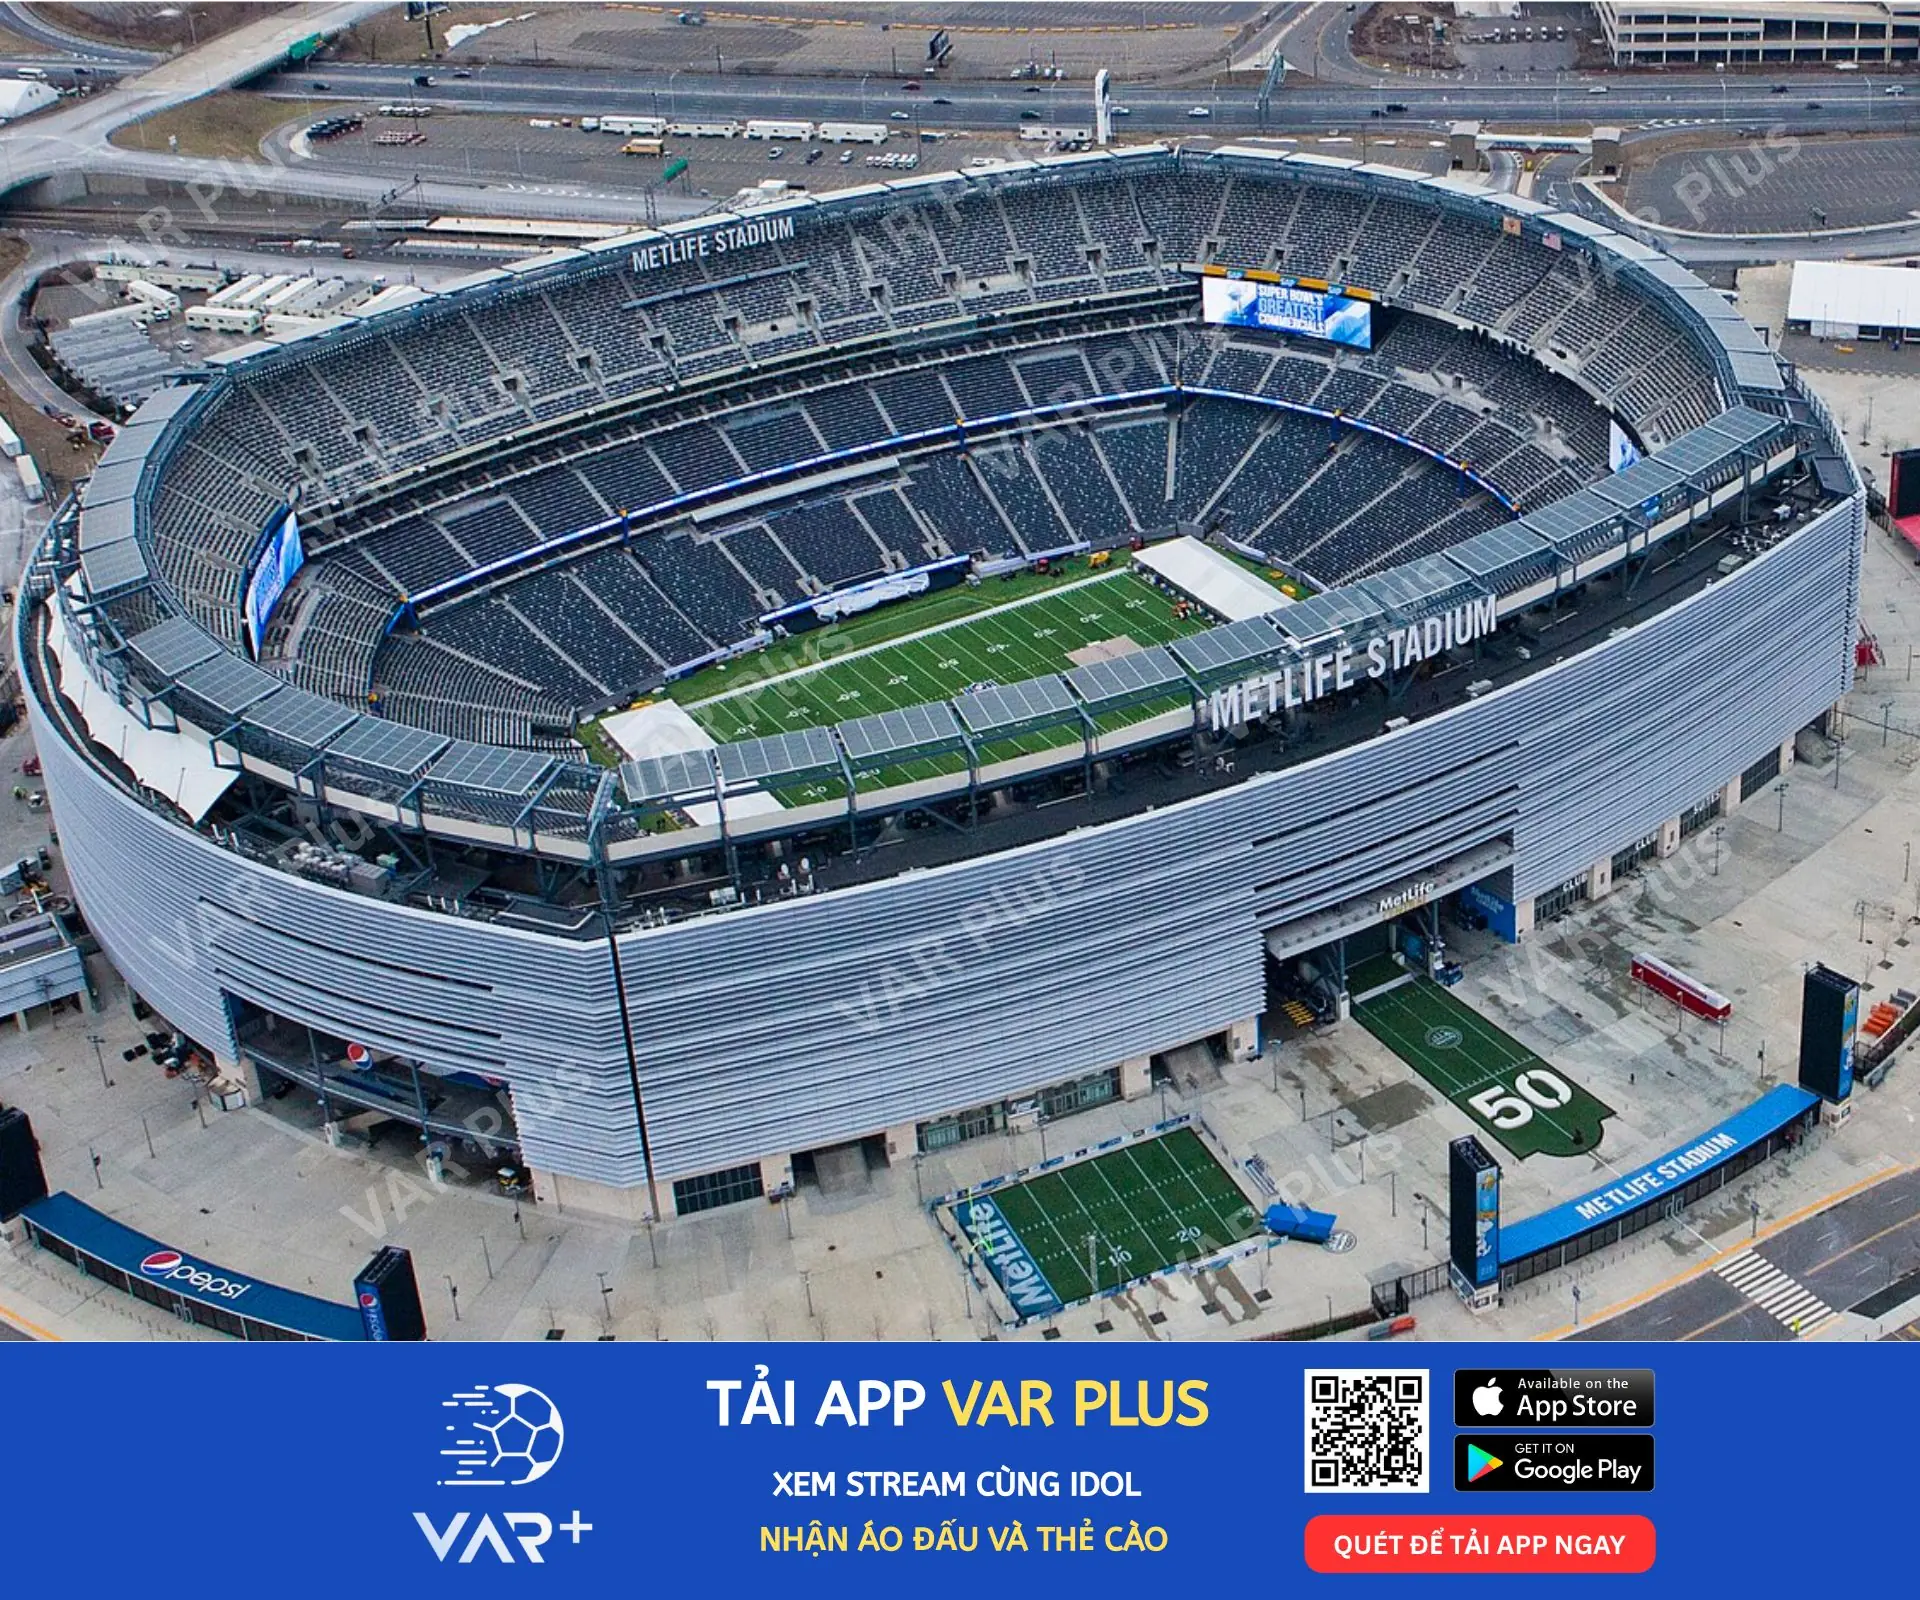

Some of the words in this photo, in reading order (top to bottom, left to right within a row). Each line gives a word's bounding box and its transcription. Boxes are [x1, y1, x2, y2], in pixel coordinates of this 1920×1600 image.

[632, 235, 710, 272] METLIFE
[714, 216, 794, 253] STADIUM
[1258, 284, 1289, 300] SUPER
[1258, 297, 1325, 322] GREATEST
[1258, 312, 1326, 334] COMMERCIALS
[1210, 647, 1354, 732] METLIFE
[1366, 593, 1497, 679] STADIUM
[1379, 881, 1434, 912] MetLife
[1468, 1069, 1573, 1129] 50
[1575, 1172, 1664, 1220] METLIFE
[1656, 1132, 1739, 1180] STADIUM
[968, 1202, 1054, 1306] MetLife
[164, 1265, 252, 1300] pepsi
